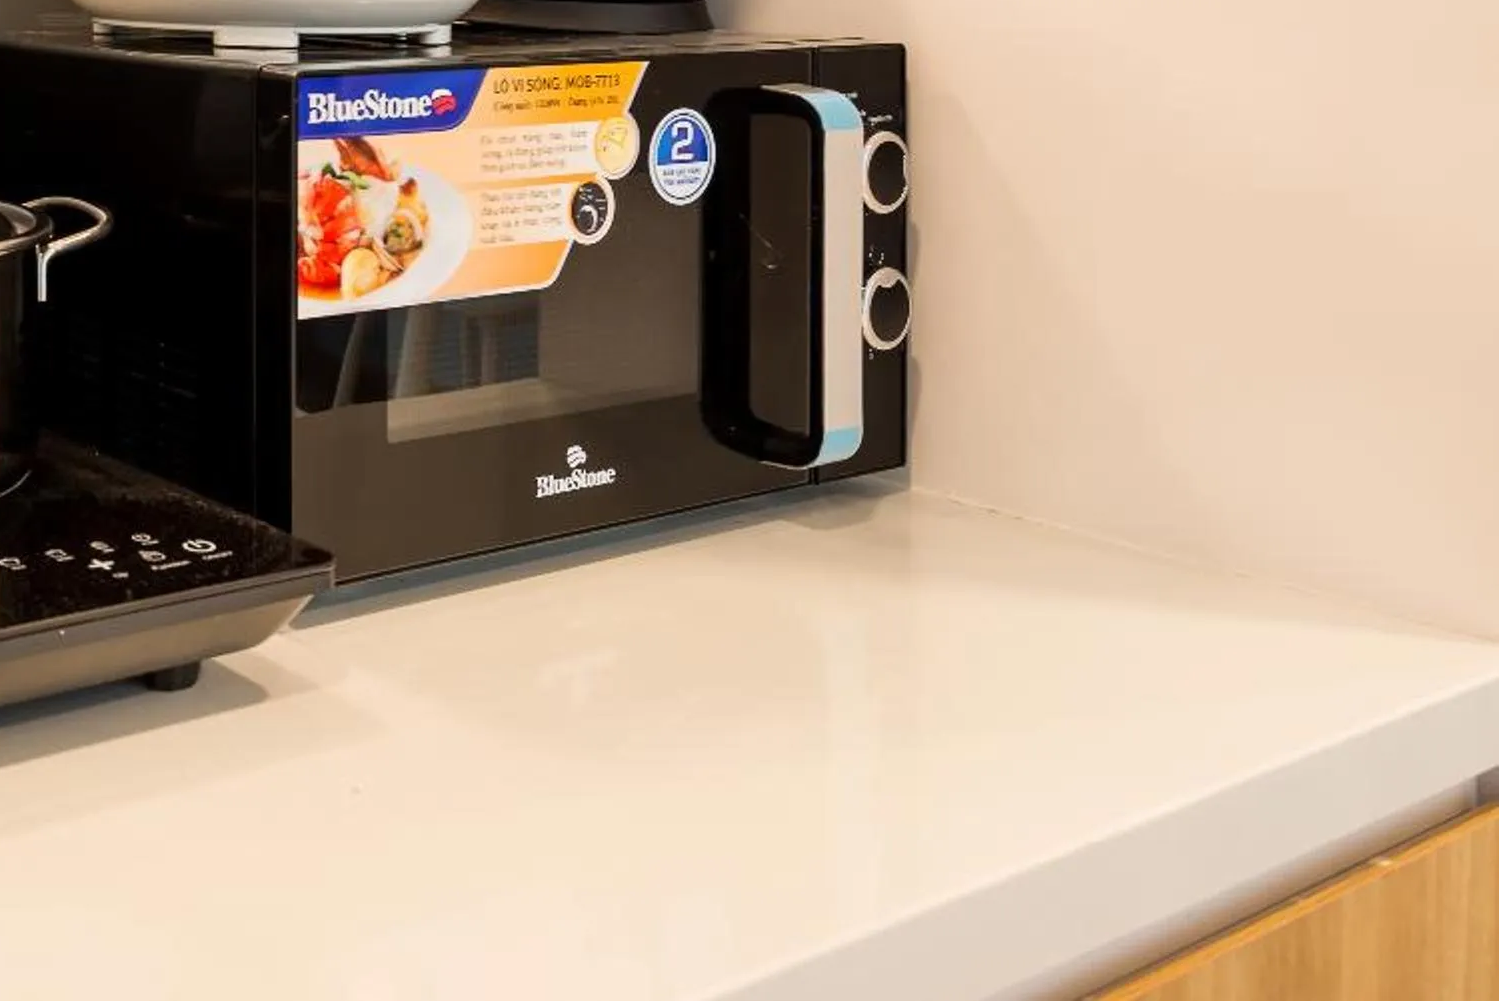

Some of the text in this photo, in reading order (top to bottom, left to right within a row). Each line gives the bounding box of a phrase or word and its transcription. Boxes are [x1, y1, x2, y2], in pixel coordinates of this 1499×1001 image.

[307, 88, 432, 125] BlueStone
[671, 121, 695, 161] 2
[535, 468, 617, 498] BlueStone
